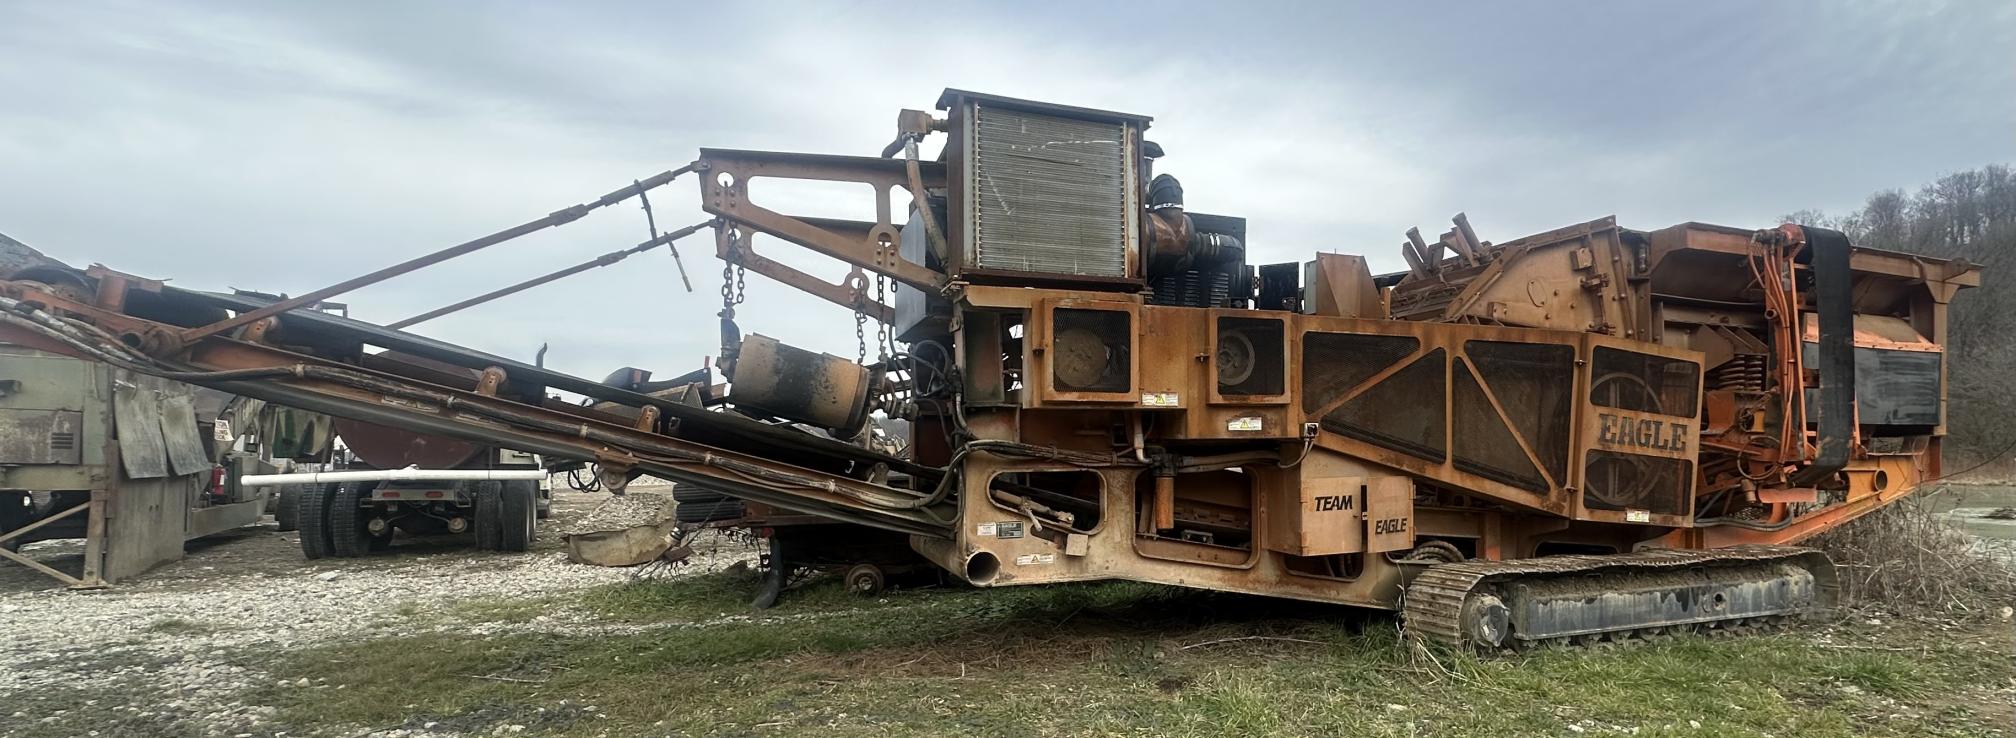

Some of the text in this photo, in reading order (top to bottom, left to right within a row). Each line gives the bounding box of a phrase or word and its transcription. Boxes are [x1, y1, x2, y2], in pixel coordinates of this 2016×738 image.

[1599, 413, 1688, 451] EAGLE
[1314, 495, 1353, 512] TEAM
[1375, 518, 1408, 535] EAGLE
